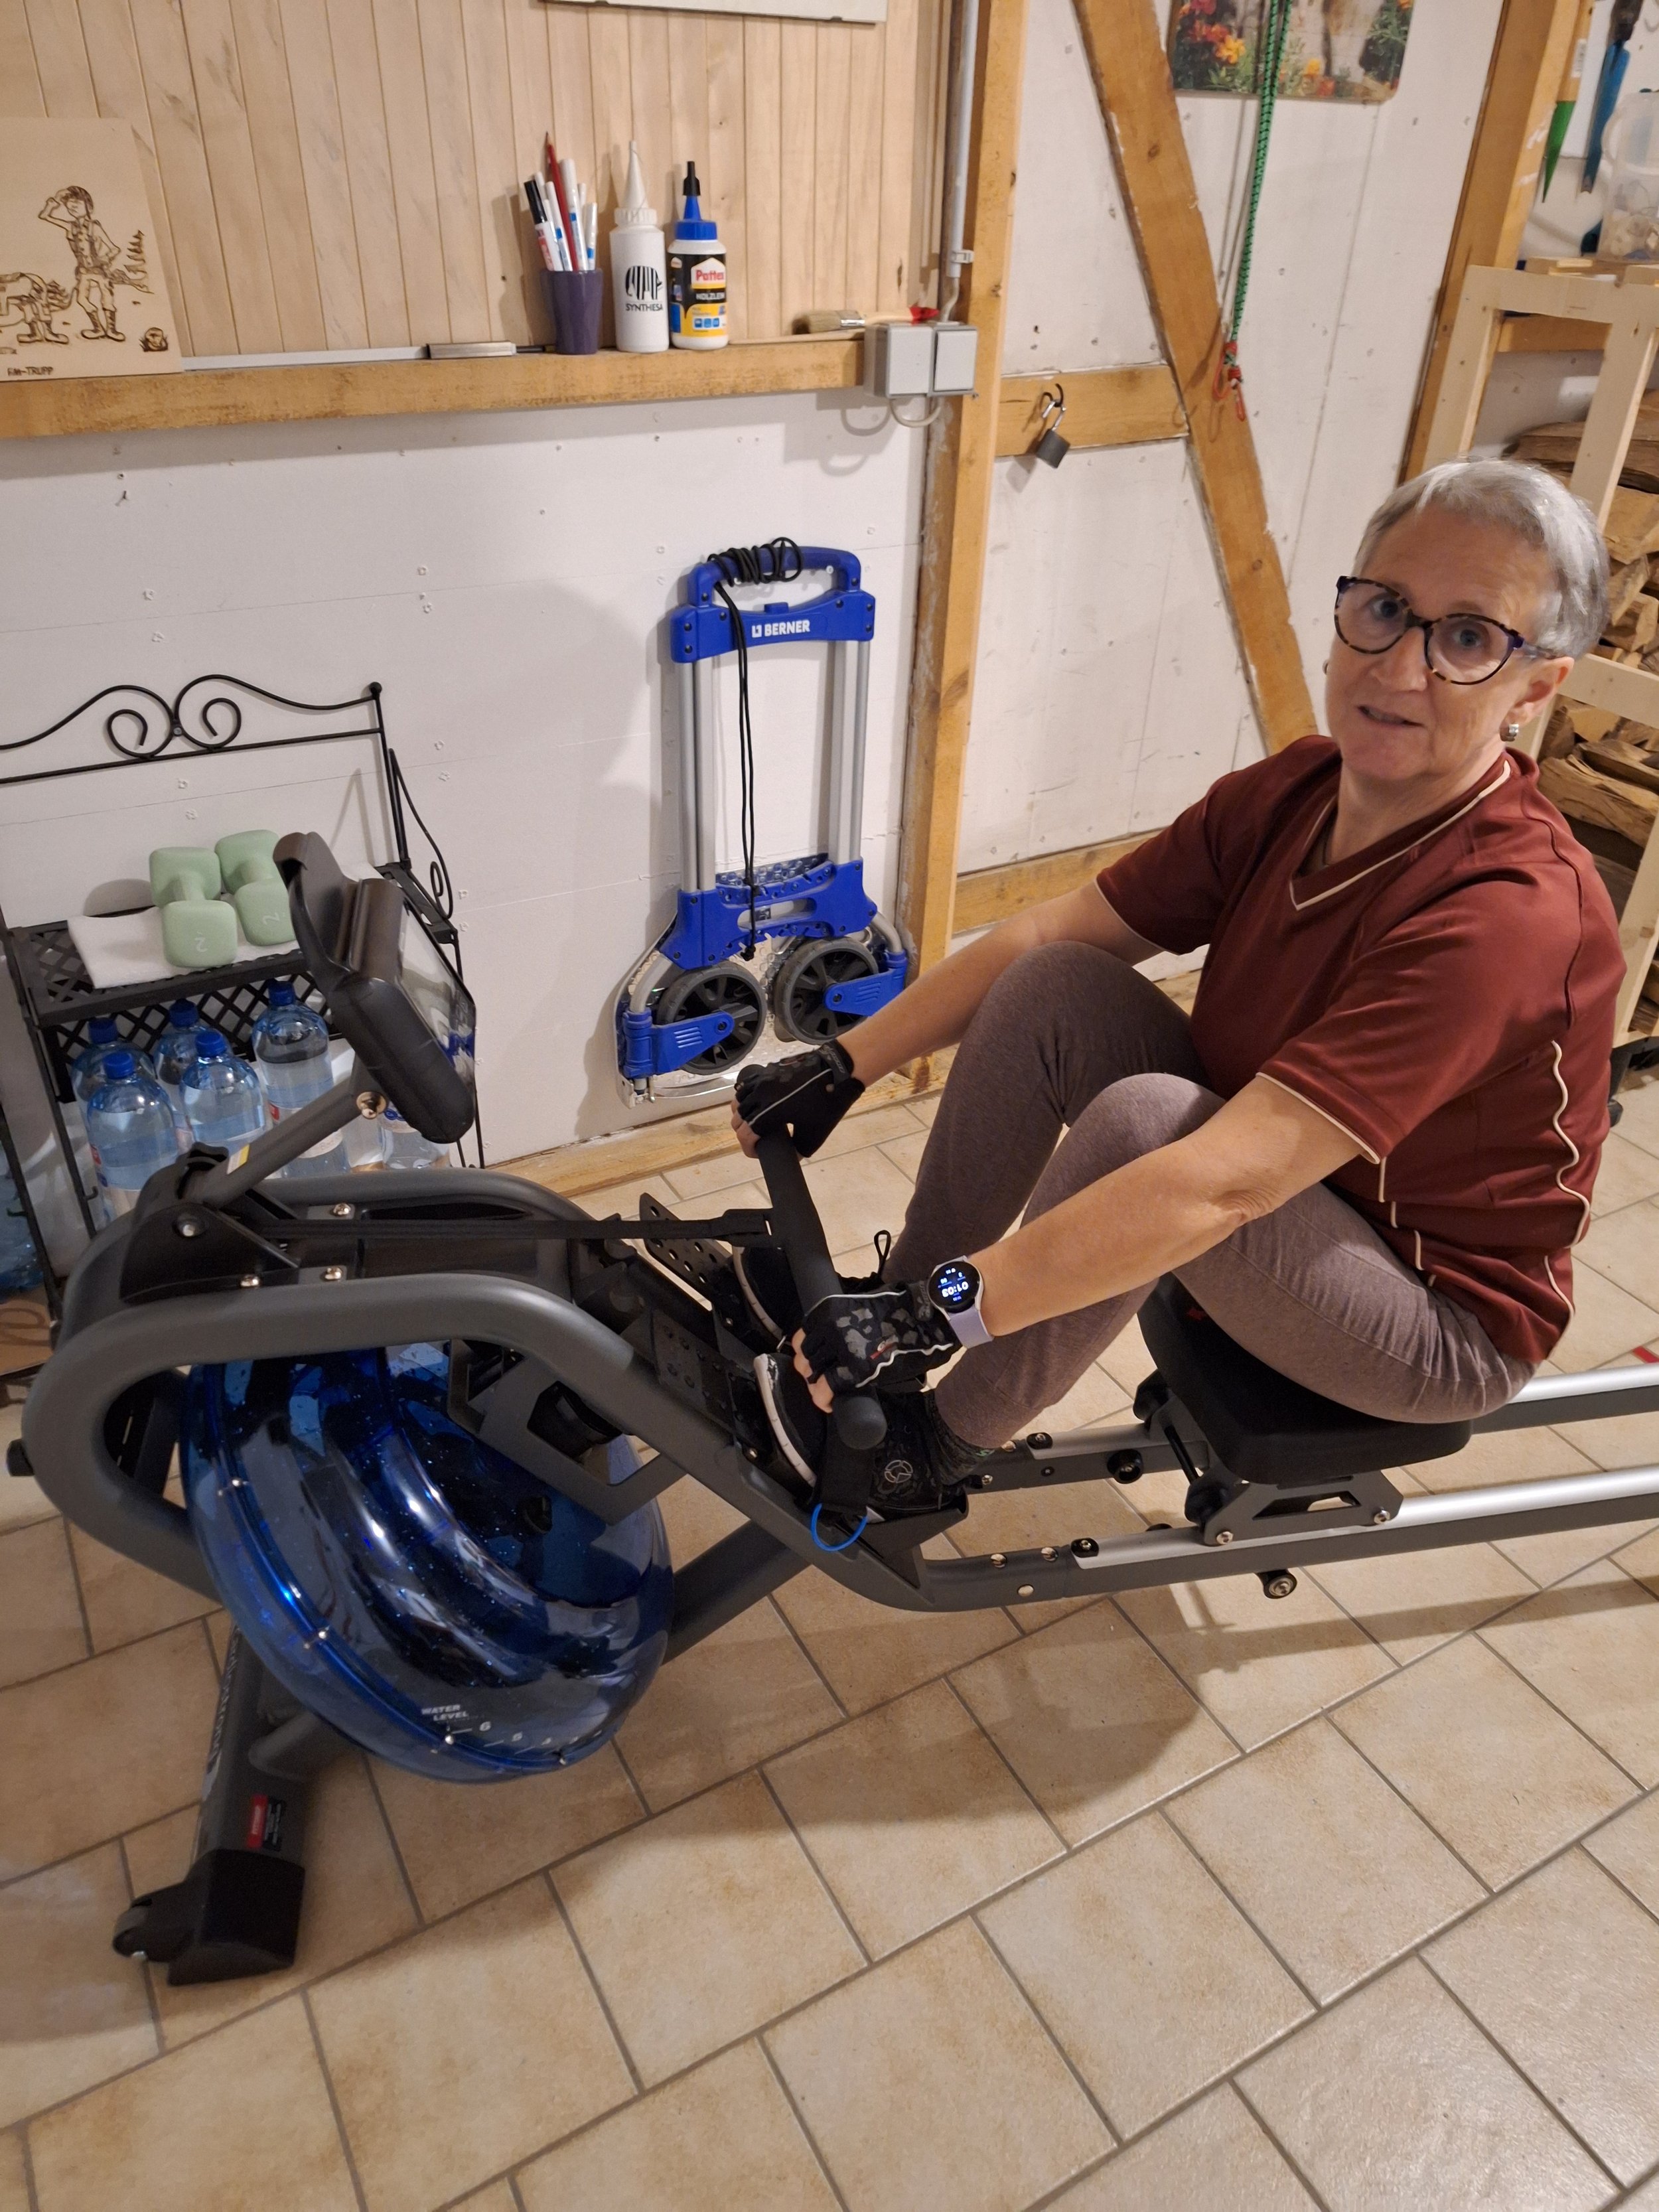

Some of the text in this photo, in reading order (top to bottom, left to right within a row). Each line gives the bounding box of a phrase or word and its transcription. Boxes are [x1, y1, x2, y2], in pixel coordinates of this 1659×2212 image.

[695, 269, 725, 280] Pattex
[626, 303, 663, 311] SYNTHESA
[764, 619, 810, 637] BERNER
[942, 1281, 969, 1297] 01:03
[421, 1704, 461, 1715] WATER
[433, 1711, 468, 1722] LEVEL
[479, 1721, 492, 1732] 6
